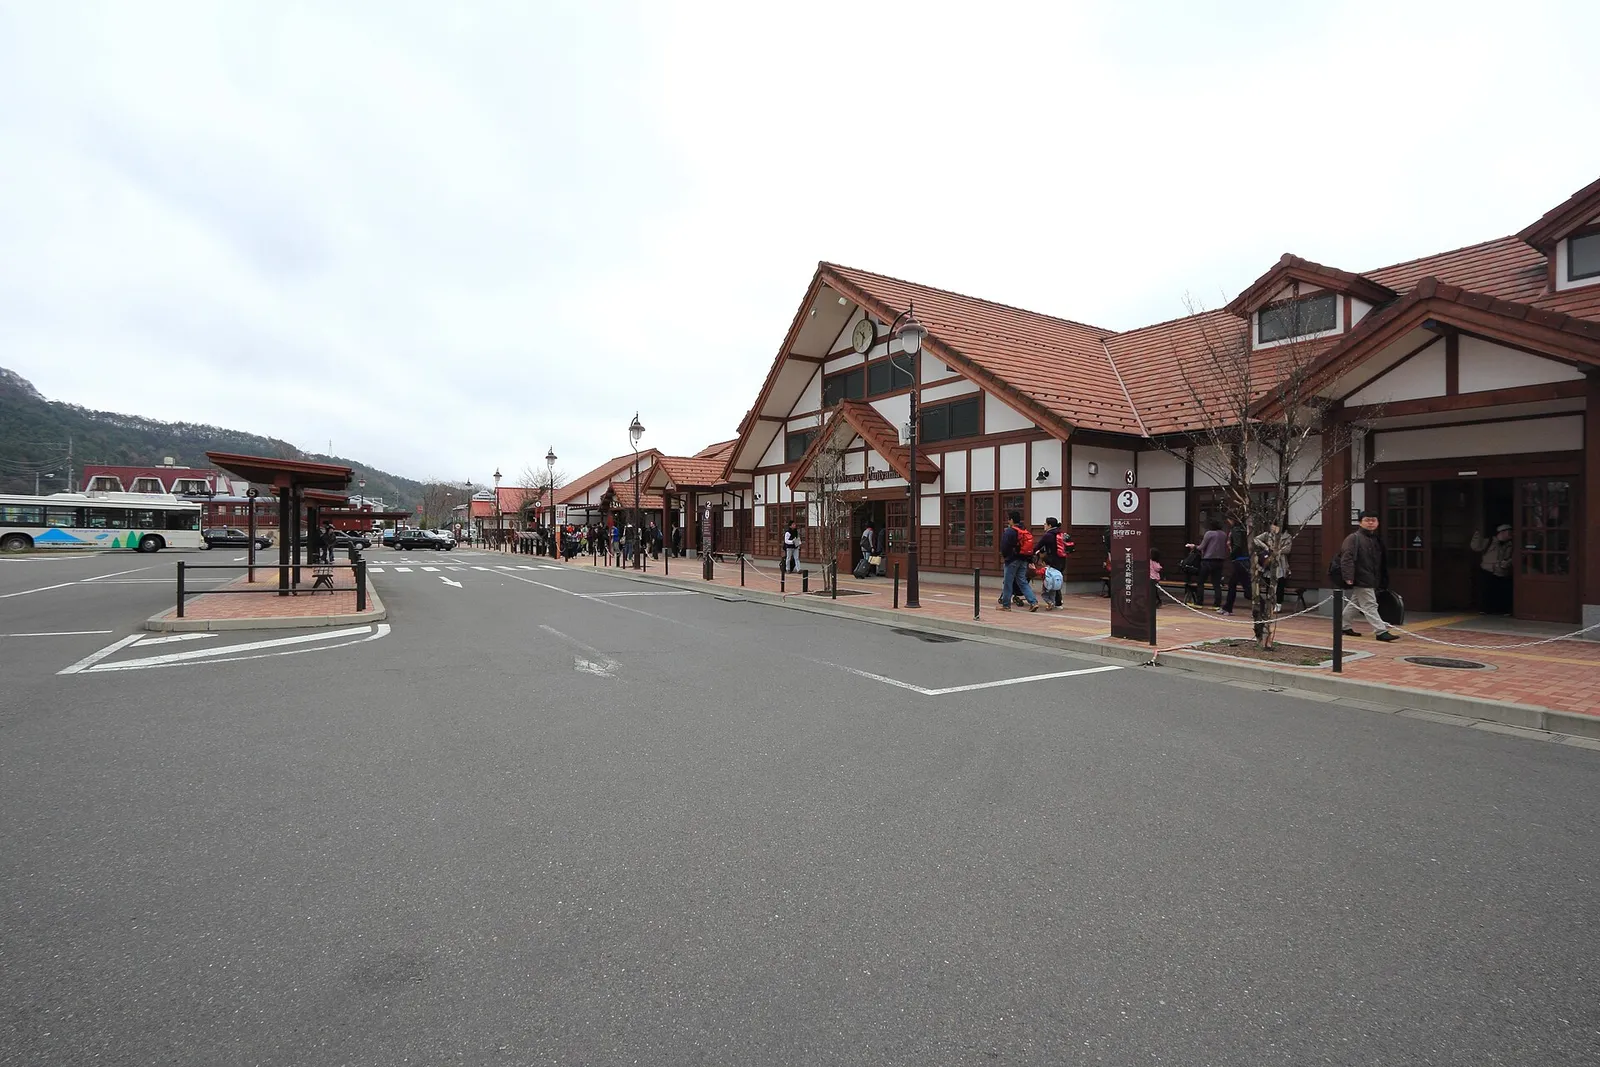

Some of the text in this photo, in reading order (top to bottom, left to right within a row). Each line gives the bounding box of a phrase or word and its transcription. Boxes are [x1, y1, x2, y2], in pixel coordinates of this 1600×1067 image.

[868, 466, 900, 480] Fujiyama
[1127, 471, 1133, 483] 3
[249, 488, 256, 497] 5
[1123, 491, 1133, 507] 3
